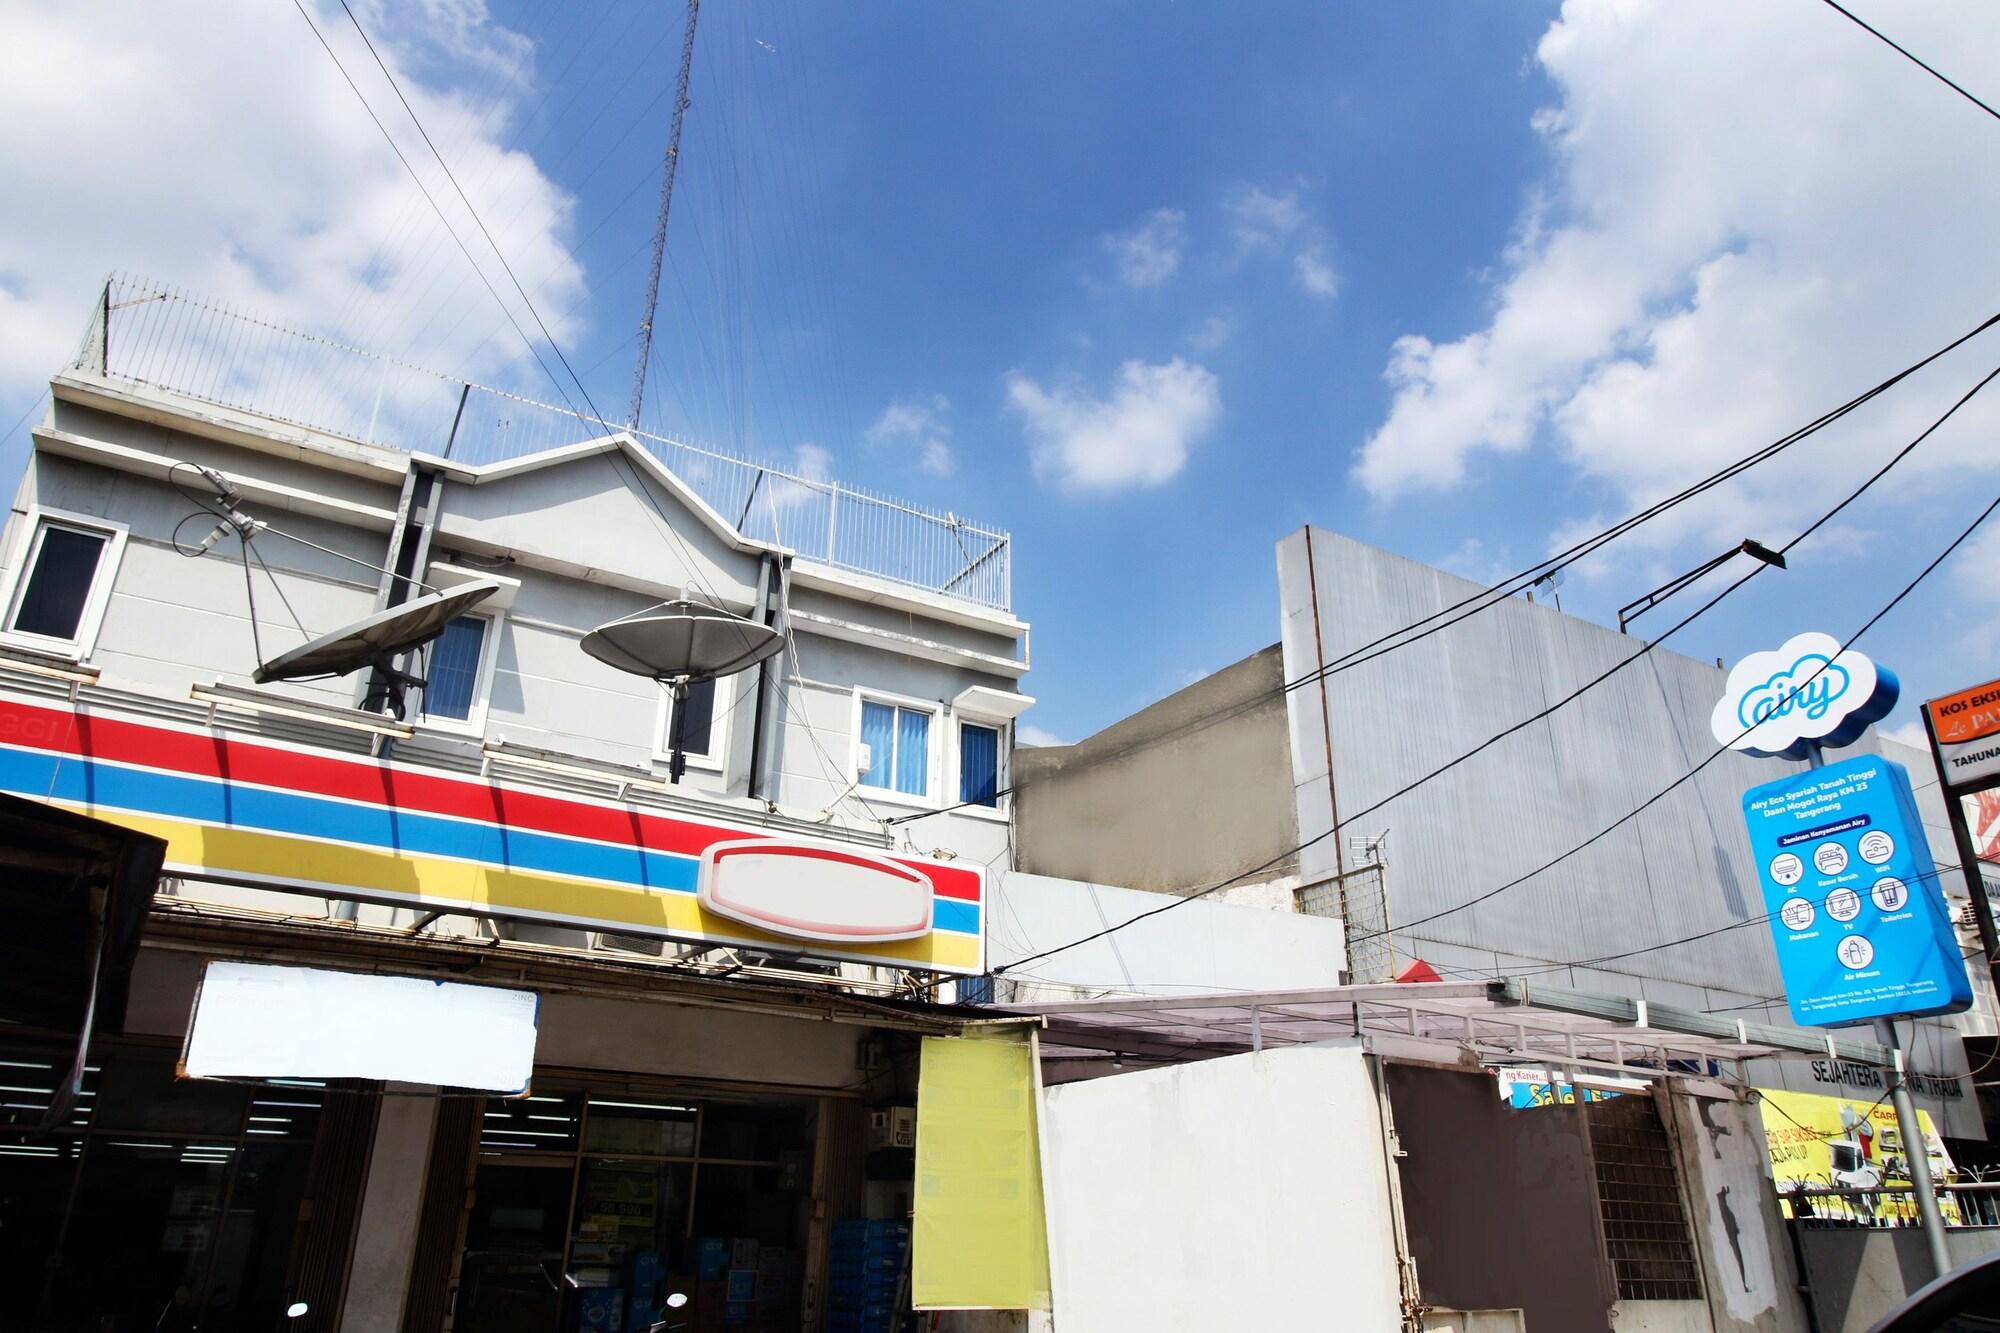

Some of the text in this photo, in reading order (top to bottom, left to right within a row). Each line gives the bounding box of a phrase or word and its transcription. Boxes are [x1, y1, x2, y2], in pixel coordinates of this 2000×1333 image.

[1753, 676, 1829, 725] airy
[1940, 700, 1968, 717] KOS
[1971, 707, 2000, 729] PA
[1751, 768, 1876, 811] Airy Eco Syariah Tanah Tinggi
[1764, 782, 1868, 817] Daan Mogot Raya KM 23
[1794, 802, 1841, 820] Tangerang
[1783, 818, 1866, 845] Jaminan Kenyamanan Airy
[1811, 1061, 1882, 1088] SEJAHTERA
[1924, 1074, 1964, 1097] TRADA
